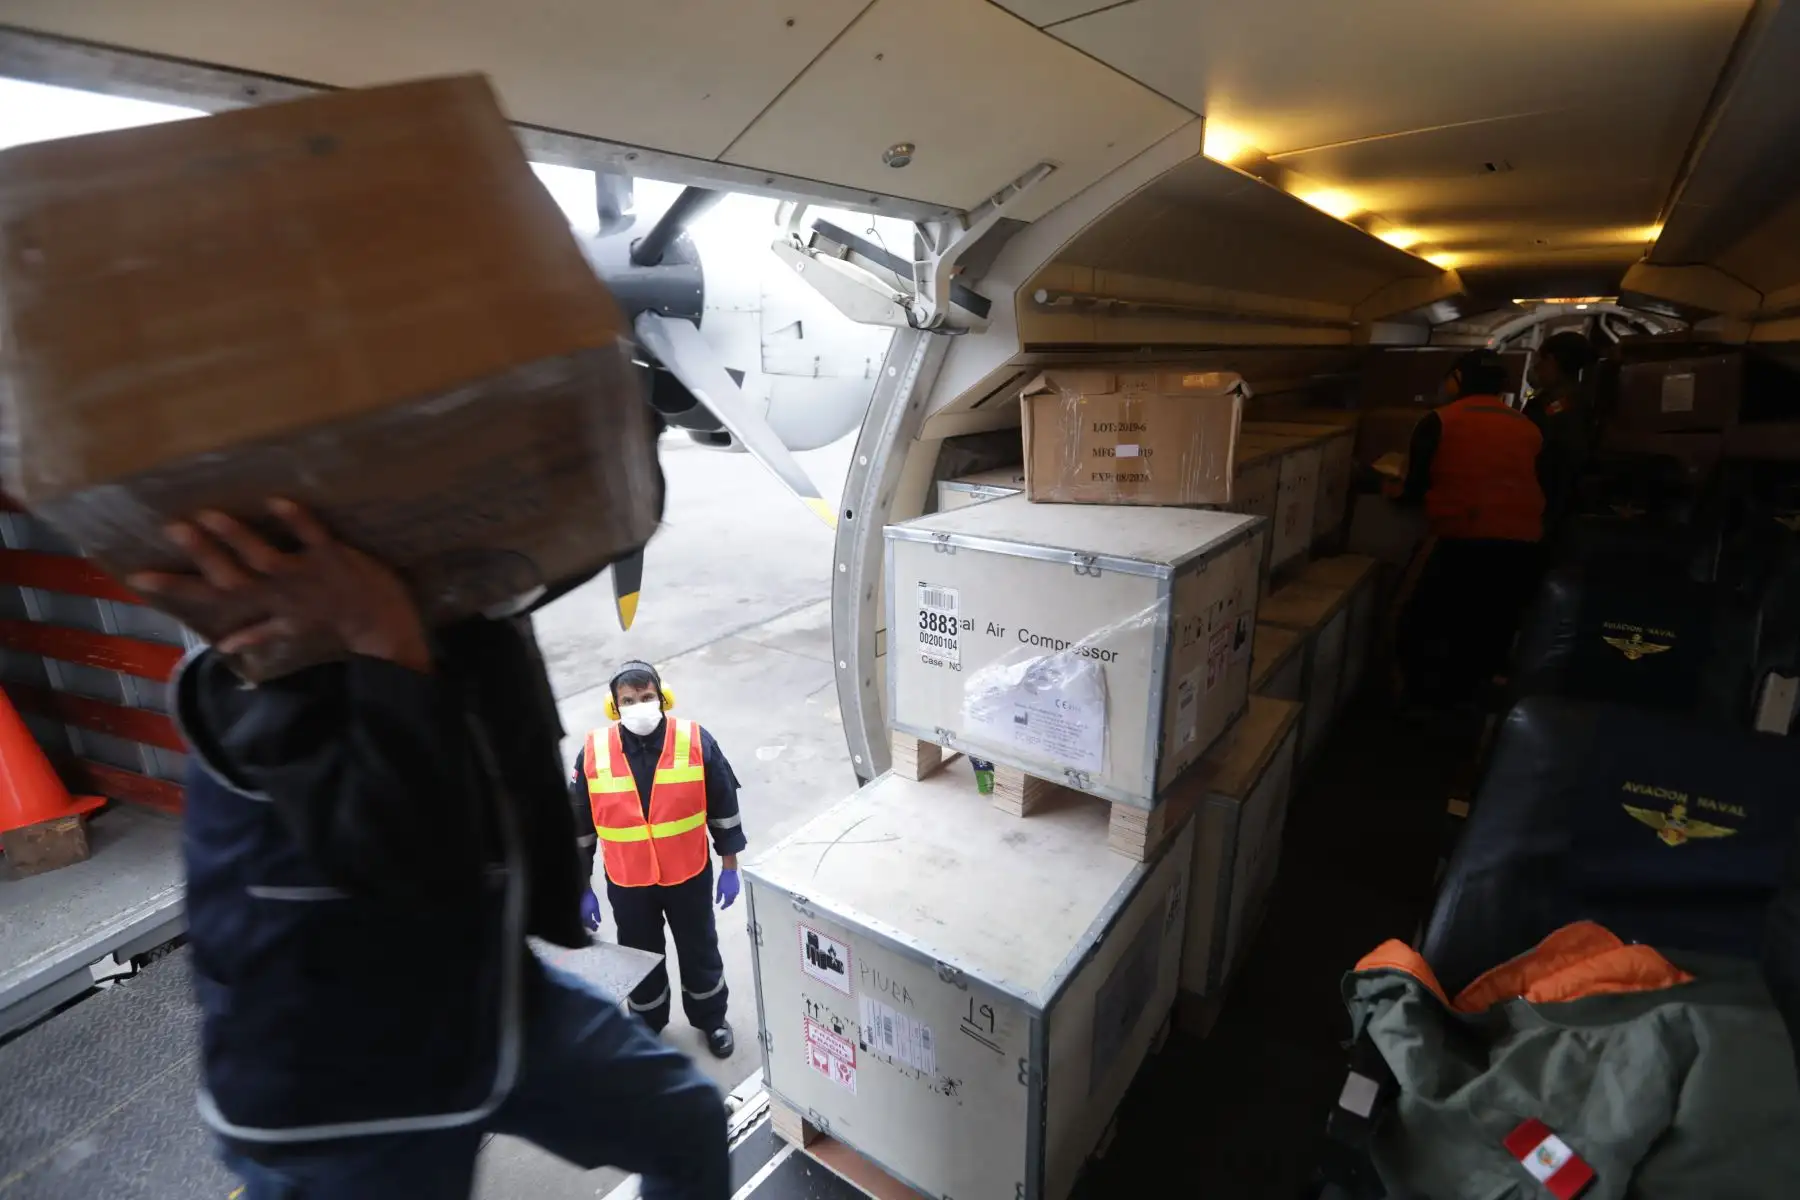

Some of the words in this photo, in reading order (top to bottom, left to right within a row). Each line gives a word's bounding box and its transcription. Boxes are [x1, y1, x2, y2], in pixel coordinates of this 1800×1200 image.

[919, 610, 958, 636] 3883
[959, 617, 975, 632] al
[986, 621, 1006, 638] Air
[919, 631, 958, 651] 00200104
[921, 655, 943, 668] Case
[1622, 780, 1689, 803] AVIACION
[1697, 797, 1747, 818] NAVAL
[962, 996, 995, 1033] 19
